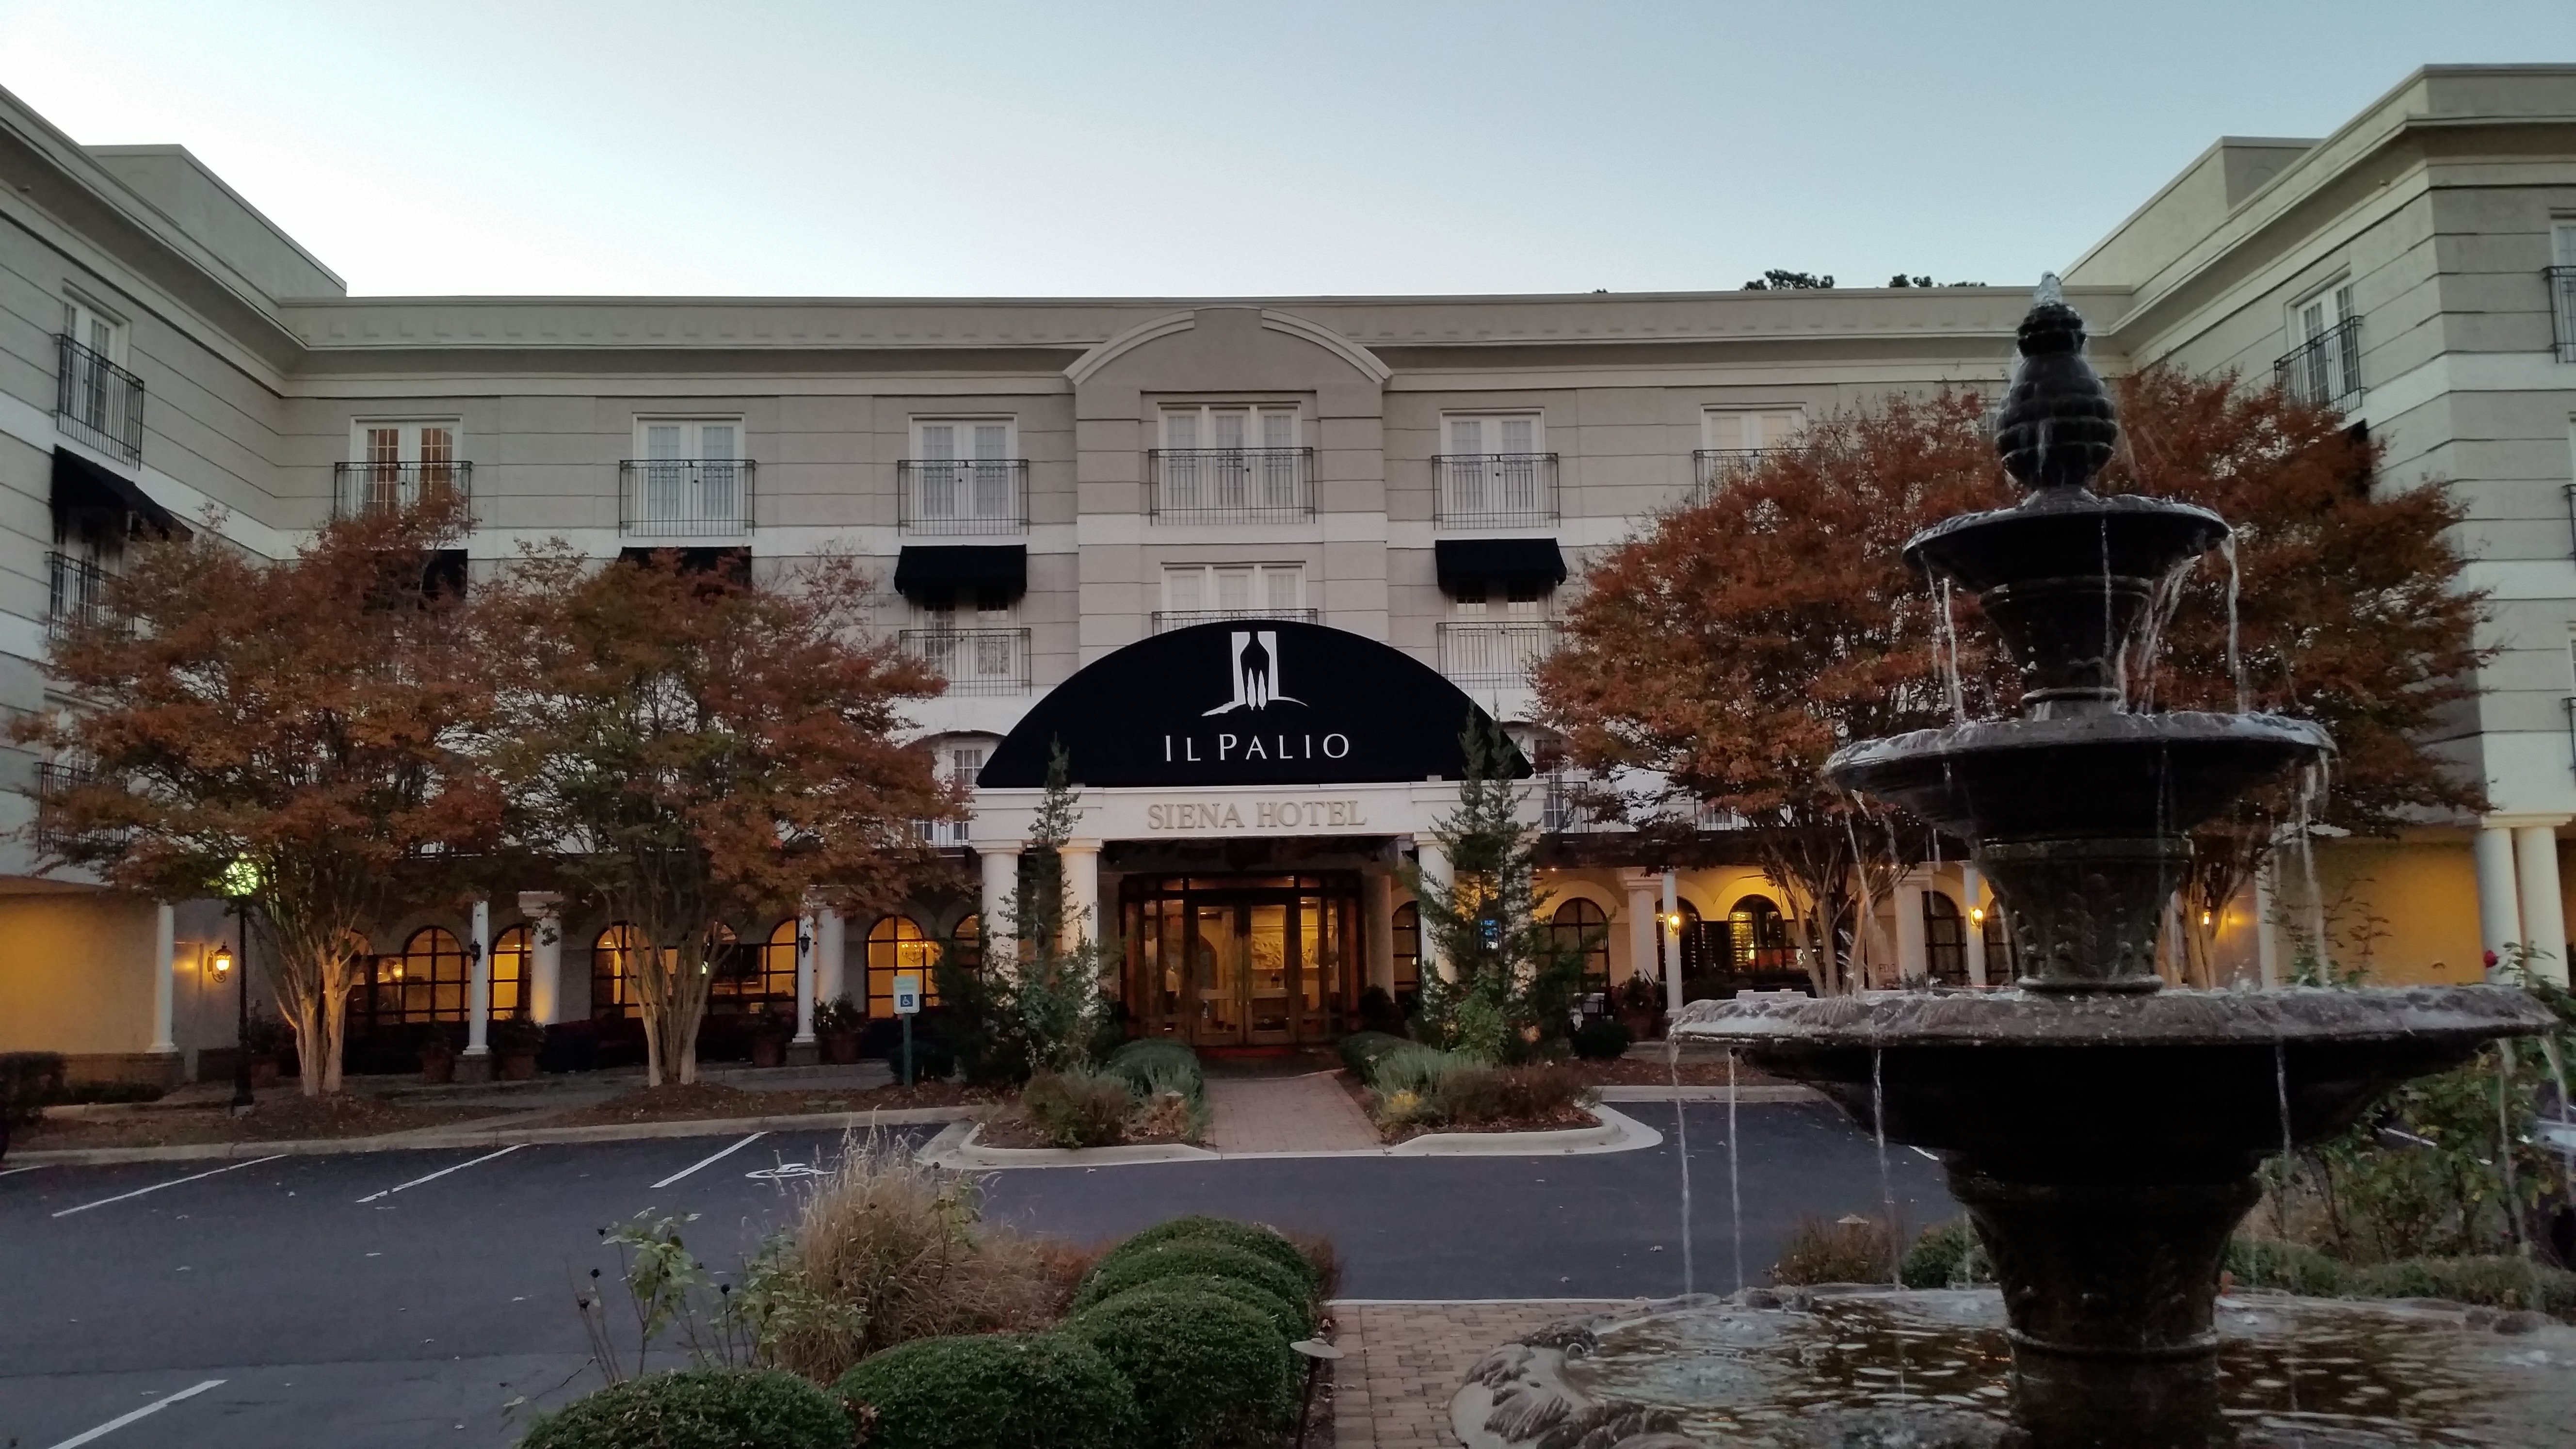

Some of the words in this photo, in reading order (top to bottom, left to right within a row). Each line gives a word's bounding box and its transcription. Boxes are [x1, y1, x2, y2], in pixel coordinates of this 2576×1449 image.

[1165, 735, 1201, 761] IL
[1219, 733, 1349, 760] PALIO
[1148, 803, 1245, 829] SIENA
[1256, 801, 1368, 827] HOTEL
